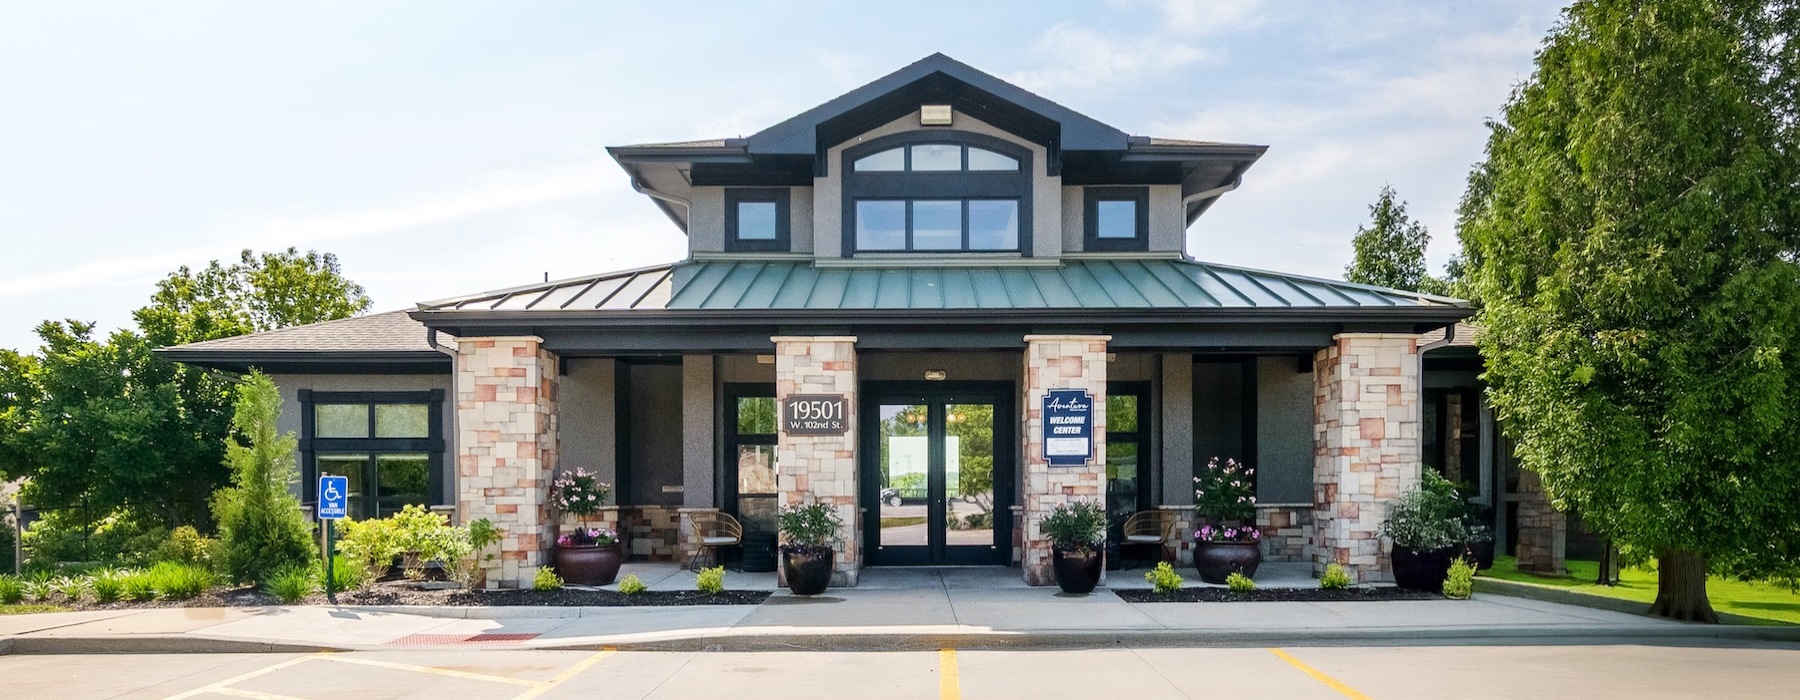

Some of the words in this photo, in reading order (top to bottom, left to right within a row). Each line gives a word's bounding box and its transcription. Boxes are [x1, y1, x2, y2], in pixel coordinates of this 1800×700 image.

[789, 400, 842, 420] 19501
[1049, 416, 1086, 424] WELCOME
[790, 421, 803, 429] W.
[804, 421, 829, 429] 102nd
[831, 421, 843, 429] St.
[1053, 426, 1081, 434] CENTER
